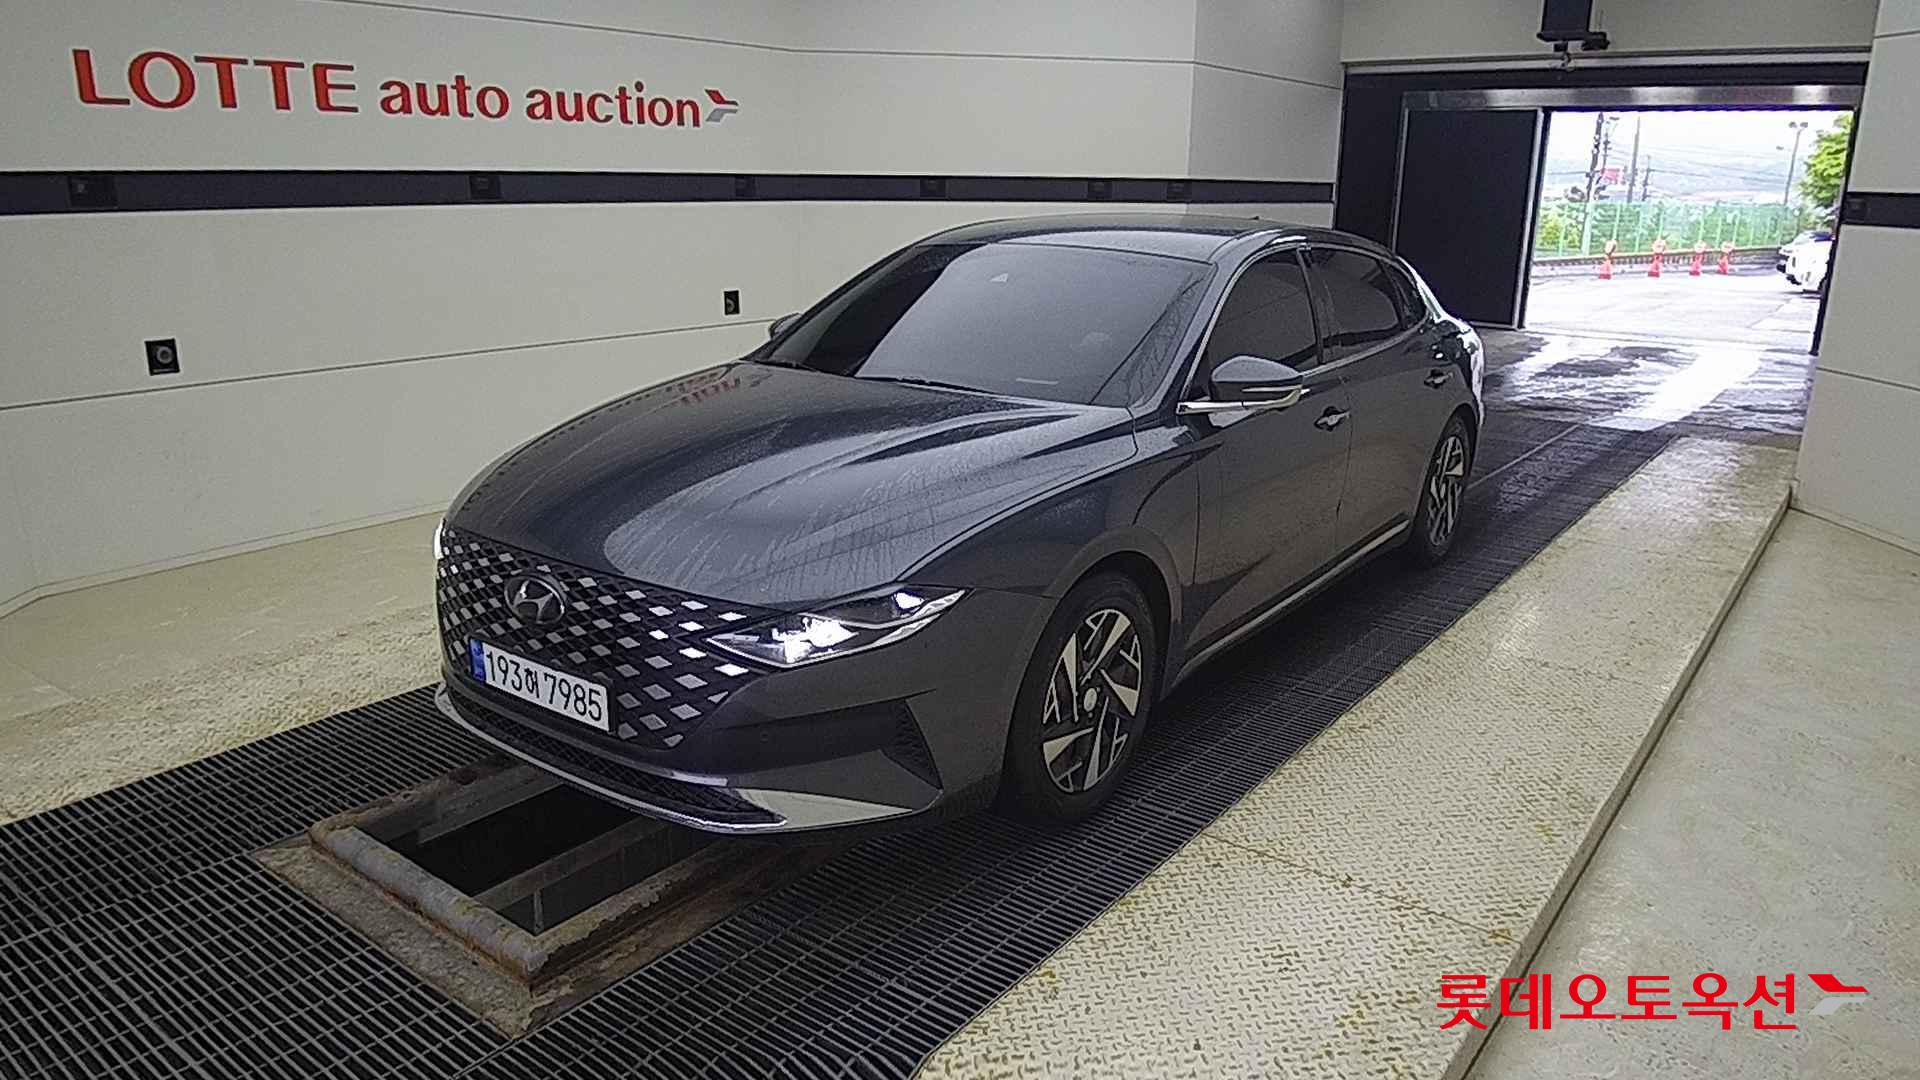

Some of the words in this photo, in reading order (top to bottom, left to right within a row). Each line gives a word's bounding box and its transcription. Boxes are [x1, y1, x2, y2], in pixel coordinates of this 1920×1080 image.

[72, 48, 360, 114] LOTTE
[379, 74, 510, 120] auto
[525, 81, 701, 128] auction
